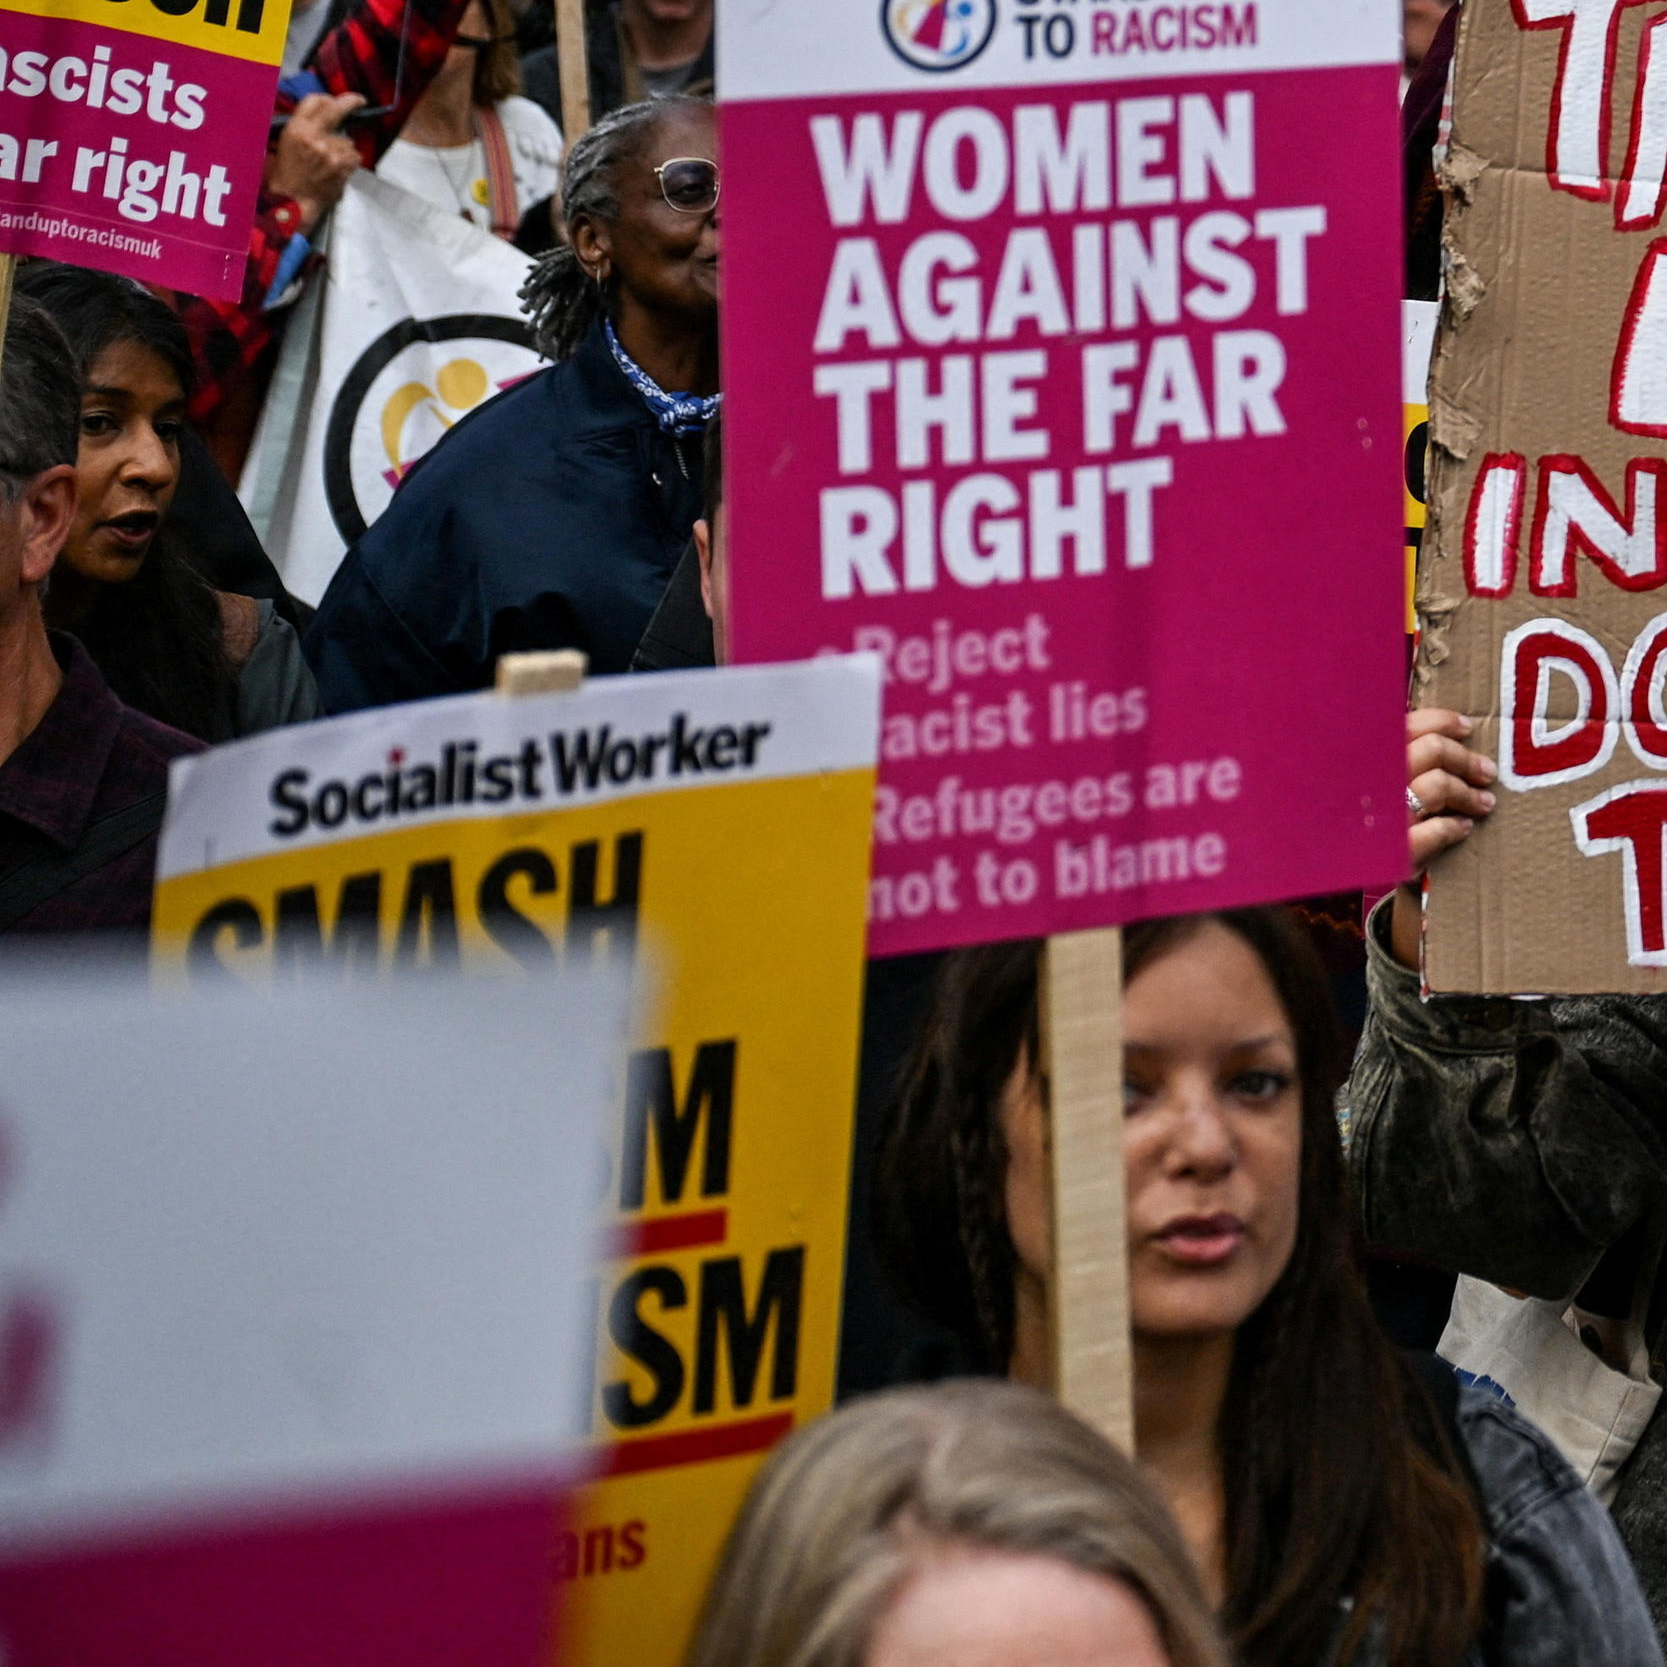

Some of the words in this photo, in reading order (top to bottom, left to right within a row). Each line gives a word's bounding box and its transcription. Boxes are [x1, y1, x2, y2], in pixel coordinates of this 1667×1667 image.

[1014, 11, 1076, 60] TO
[1091, 3, 1259, 56] RACISM
[71, 136, 232, 227] right
[809, 90, 1256, 228] WOMEN
[812, 204, 1328, 354] AGAINST
[813, 348, 1049, 476] THE
[1082, 329, 1288, 454] FAR
[819, 456, 1174, 601] RIGHT
[853, 613, 1051, 694] Reject
[1048, 682, 1147, 744] lies
[267, 738, 542, 841] Socialist
[551, 712, 772, 798] Worker
[1144, 755, 1241, 810] are
[975, 851, 1038, 907] to
[1053, 830, 1228, 899] blame
